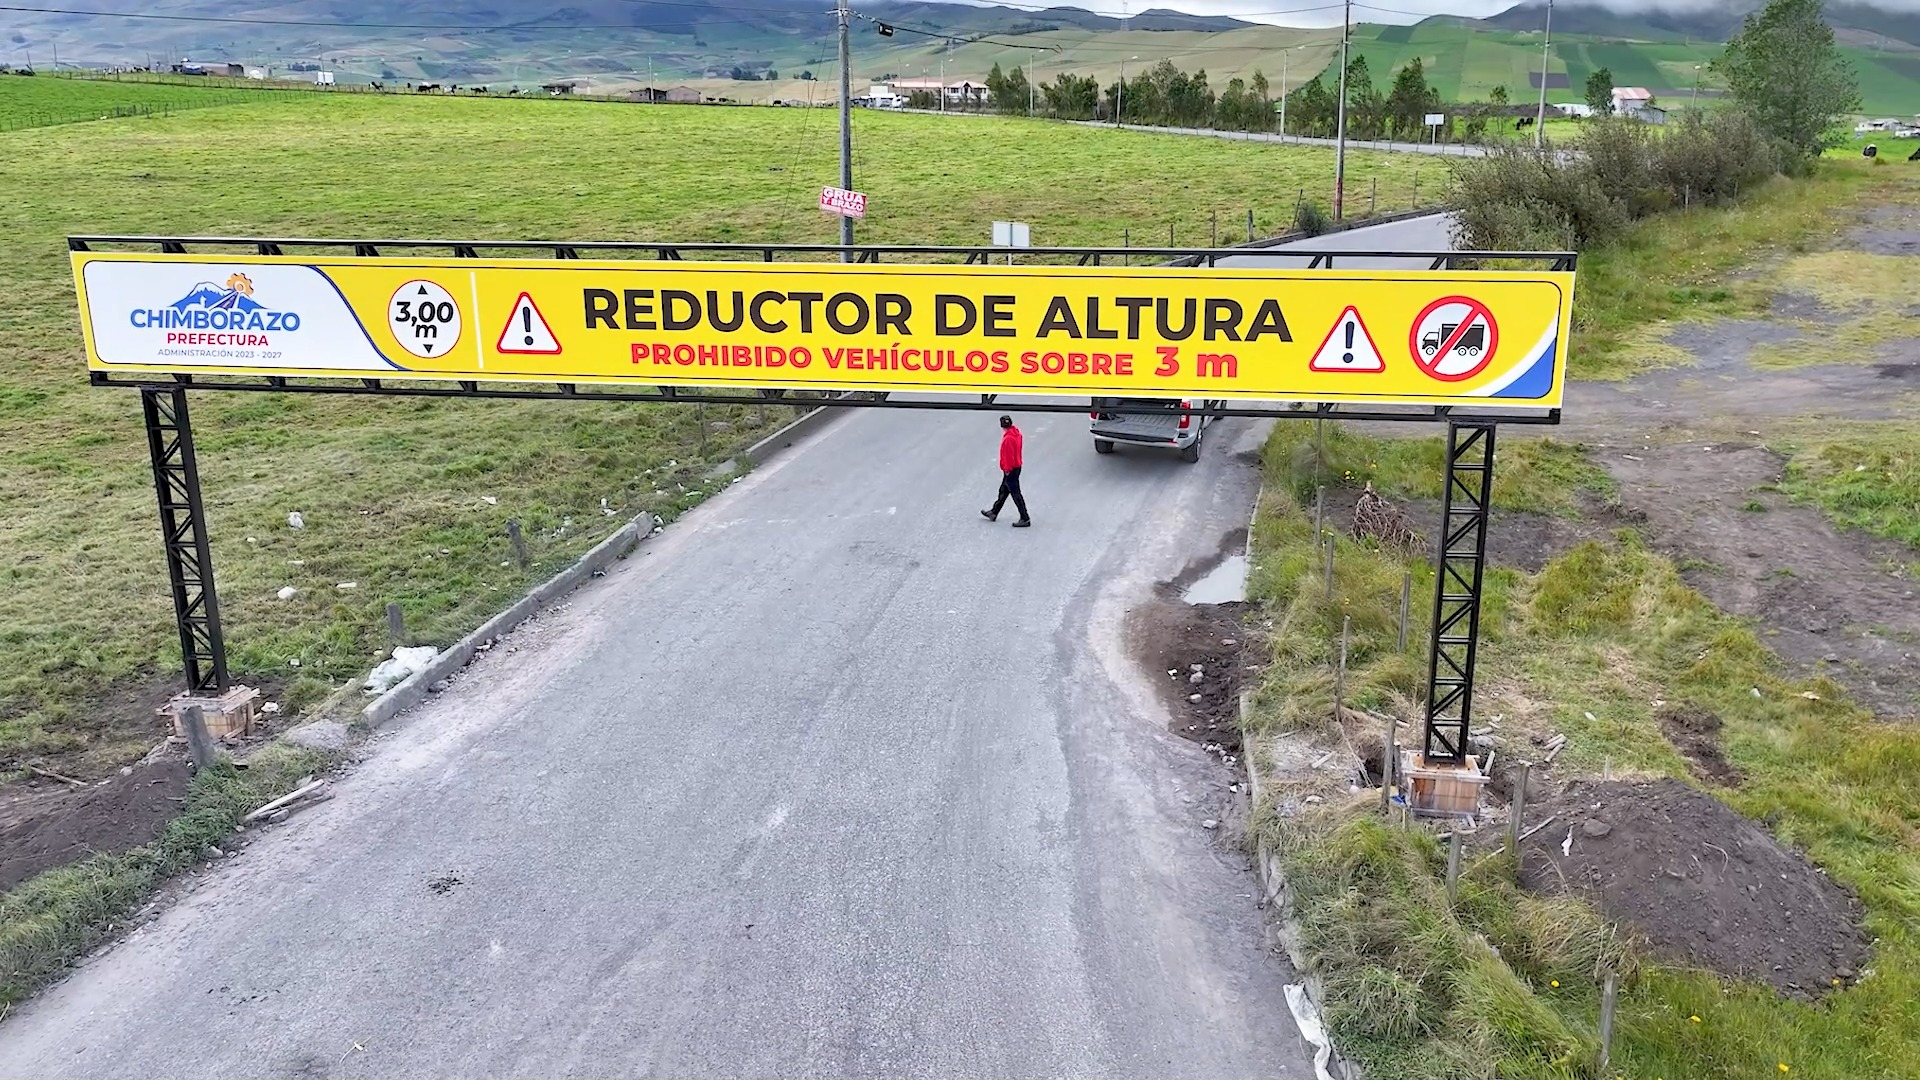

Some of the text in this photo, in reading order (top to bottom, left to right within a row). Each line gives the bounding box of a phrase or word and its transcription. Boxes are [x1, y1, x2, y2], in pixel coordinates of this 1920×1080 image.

[823, 188, 864, 204] GRUA
[831, 198, 863, 212] BRAZO
[130, 308, 300, 332] CHIMBORAZO
[395, 301, 454, 327] 3,00
[583, 288, 1293, 343] REDUCTOR DE ALTURA
[415, 324, 437, 338] m
[167, 333, 269, 346] PREFECTURA
[157, 349, 233, 358] ADMINISTRACIÓN
[235, 350, 254, 359] 2023
[262, 351, 282, 359] 2027
[631, 342, 1238, 378] PROHIBIDO VEHÍCULOS SOBRE 3 m
